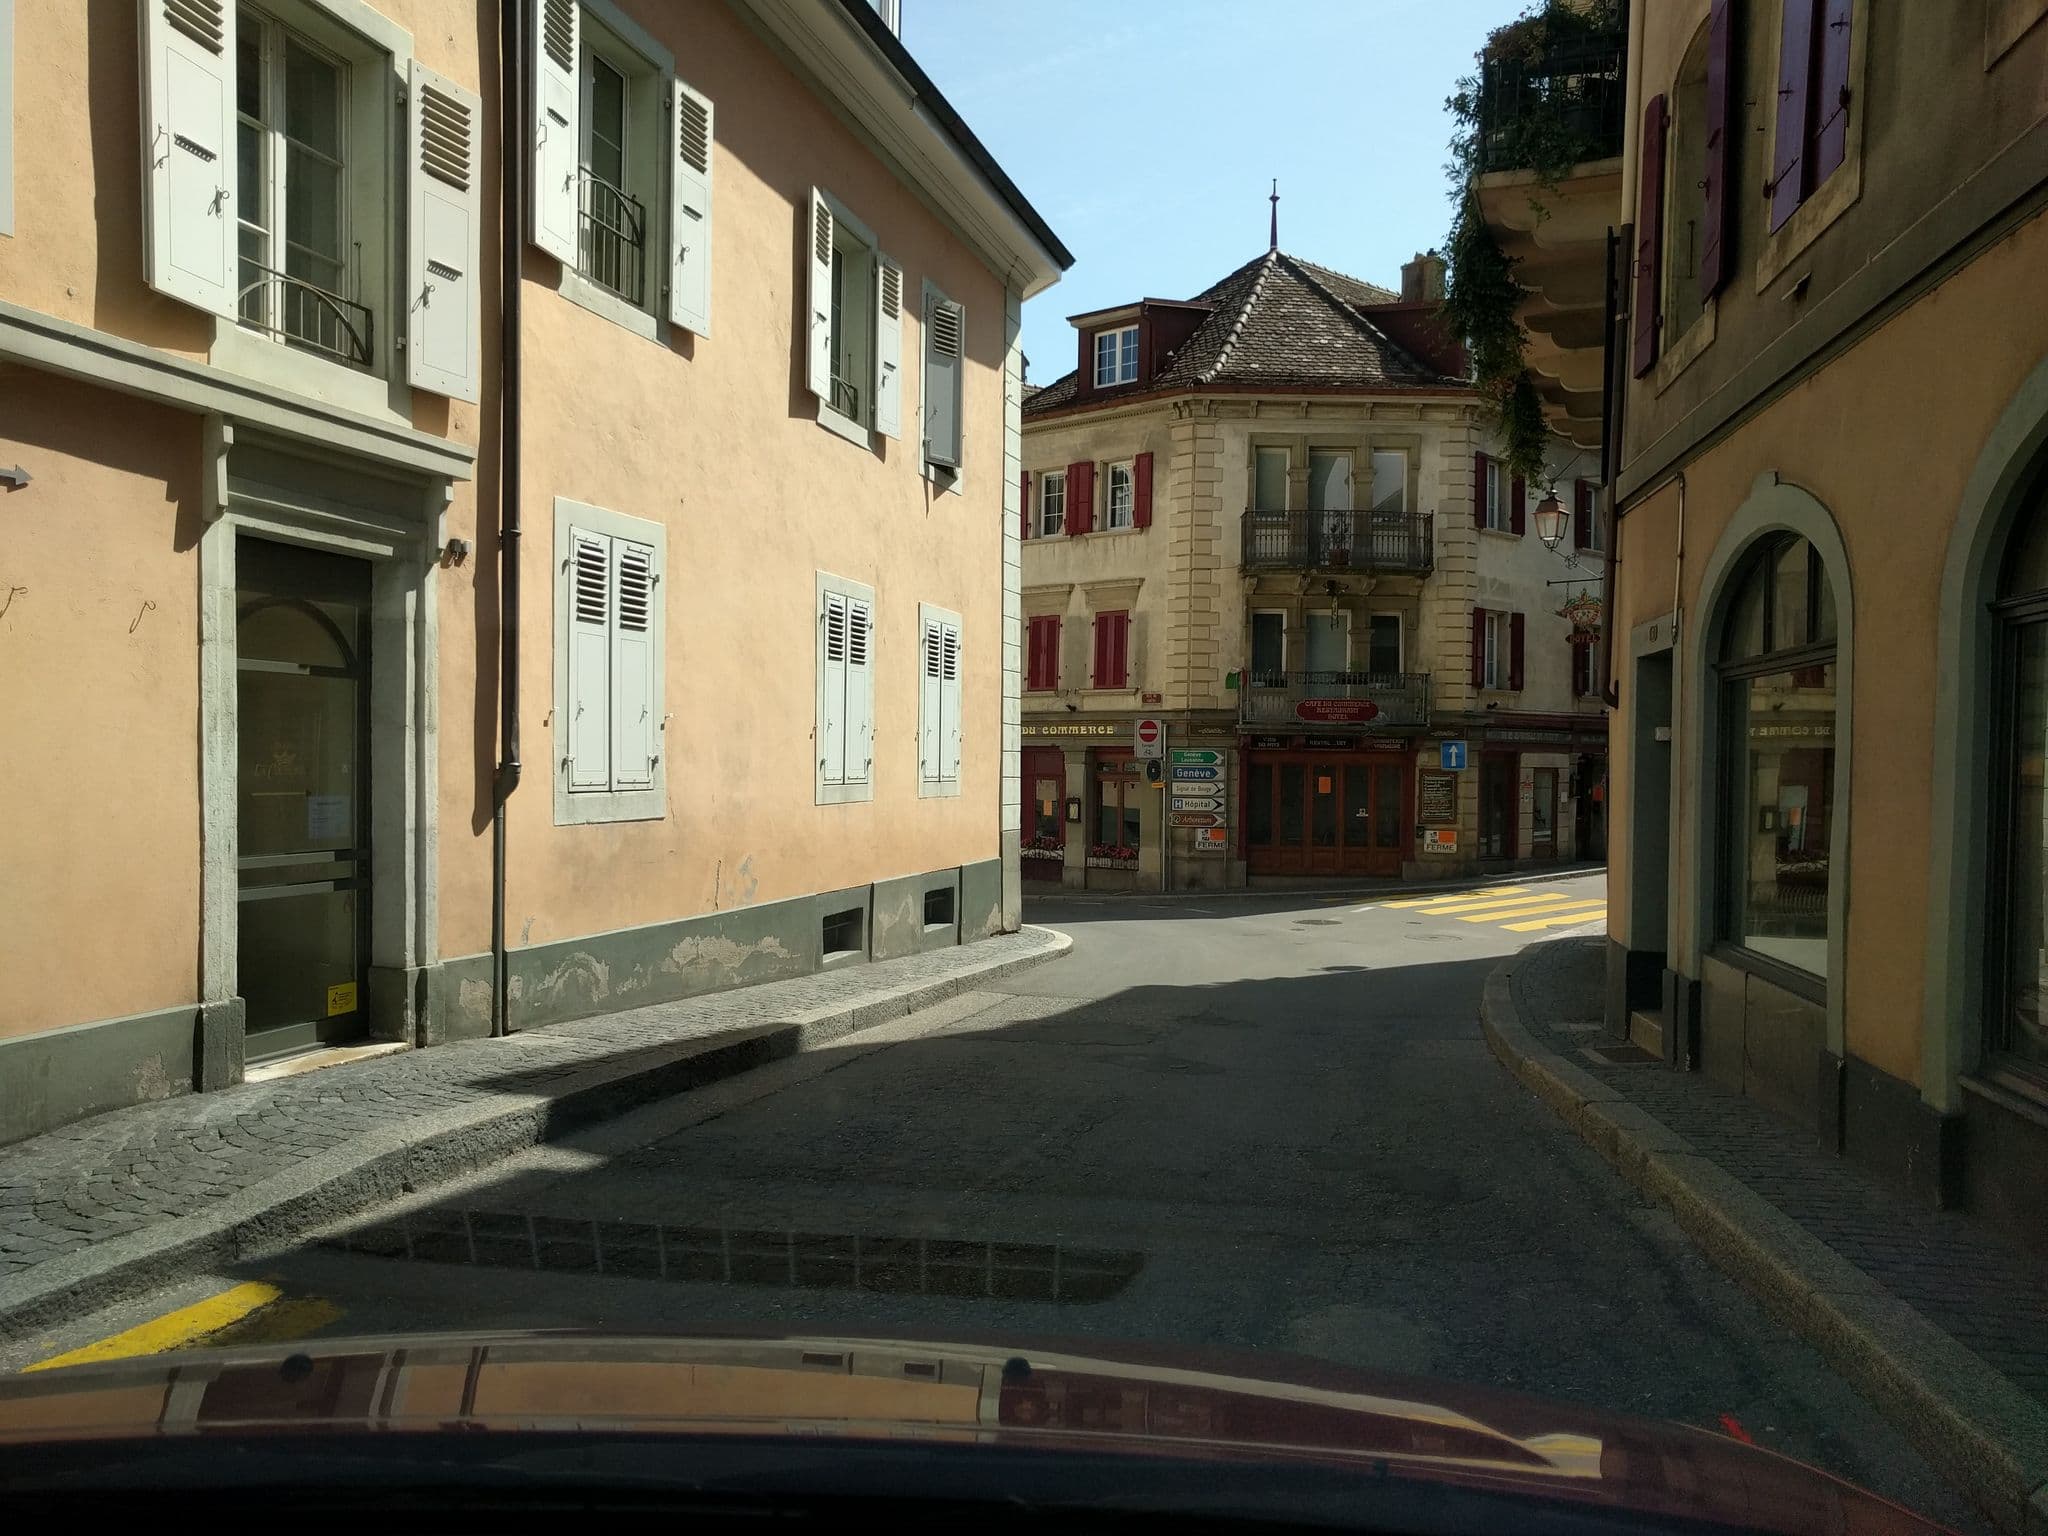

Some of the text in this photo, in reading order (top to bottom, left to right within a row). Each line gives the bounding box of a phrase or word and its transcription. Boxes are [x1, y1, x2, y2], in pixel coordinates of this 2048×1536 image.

[1022, 725, 1114, 735] DU COMMERCE
[1176, 768, 1211, 778] Genève
[1184, 799, 1211, 809] Hôpital
